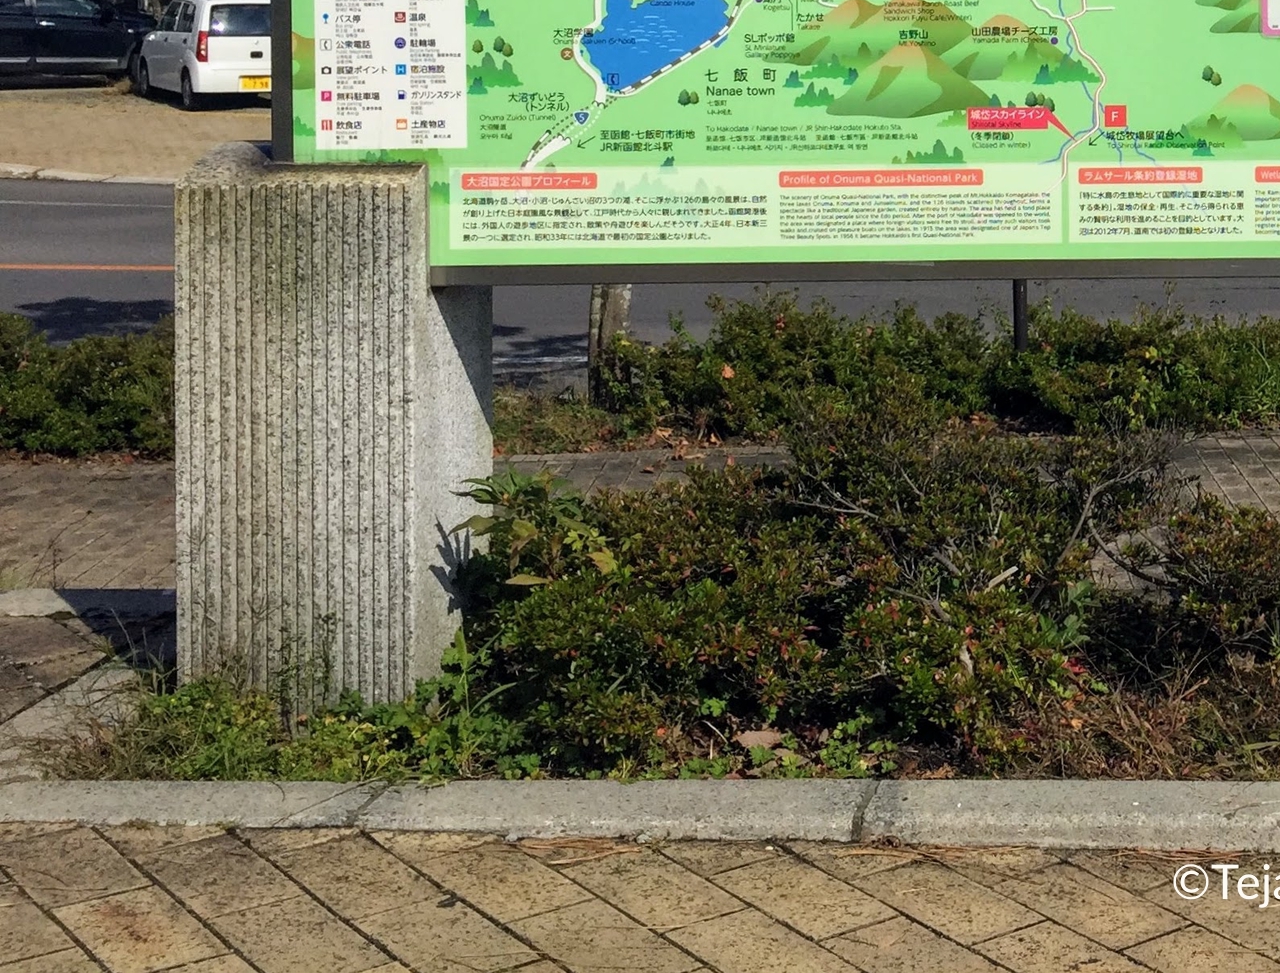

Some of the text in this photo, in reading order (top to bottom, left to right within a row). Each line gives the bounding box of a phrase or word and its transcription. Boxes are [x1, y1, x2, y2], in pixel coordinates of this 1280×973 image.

[706, 87, 777, 96] Nanae town
[1111, 111, 1119, 121] F
[783, 173, 978, 184] Profile of Onuma Quasi-National Park
